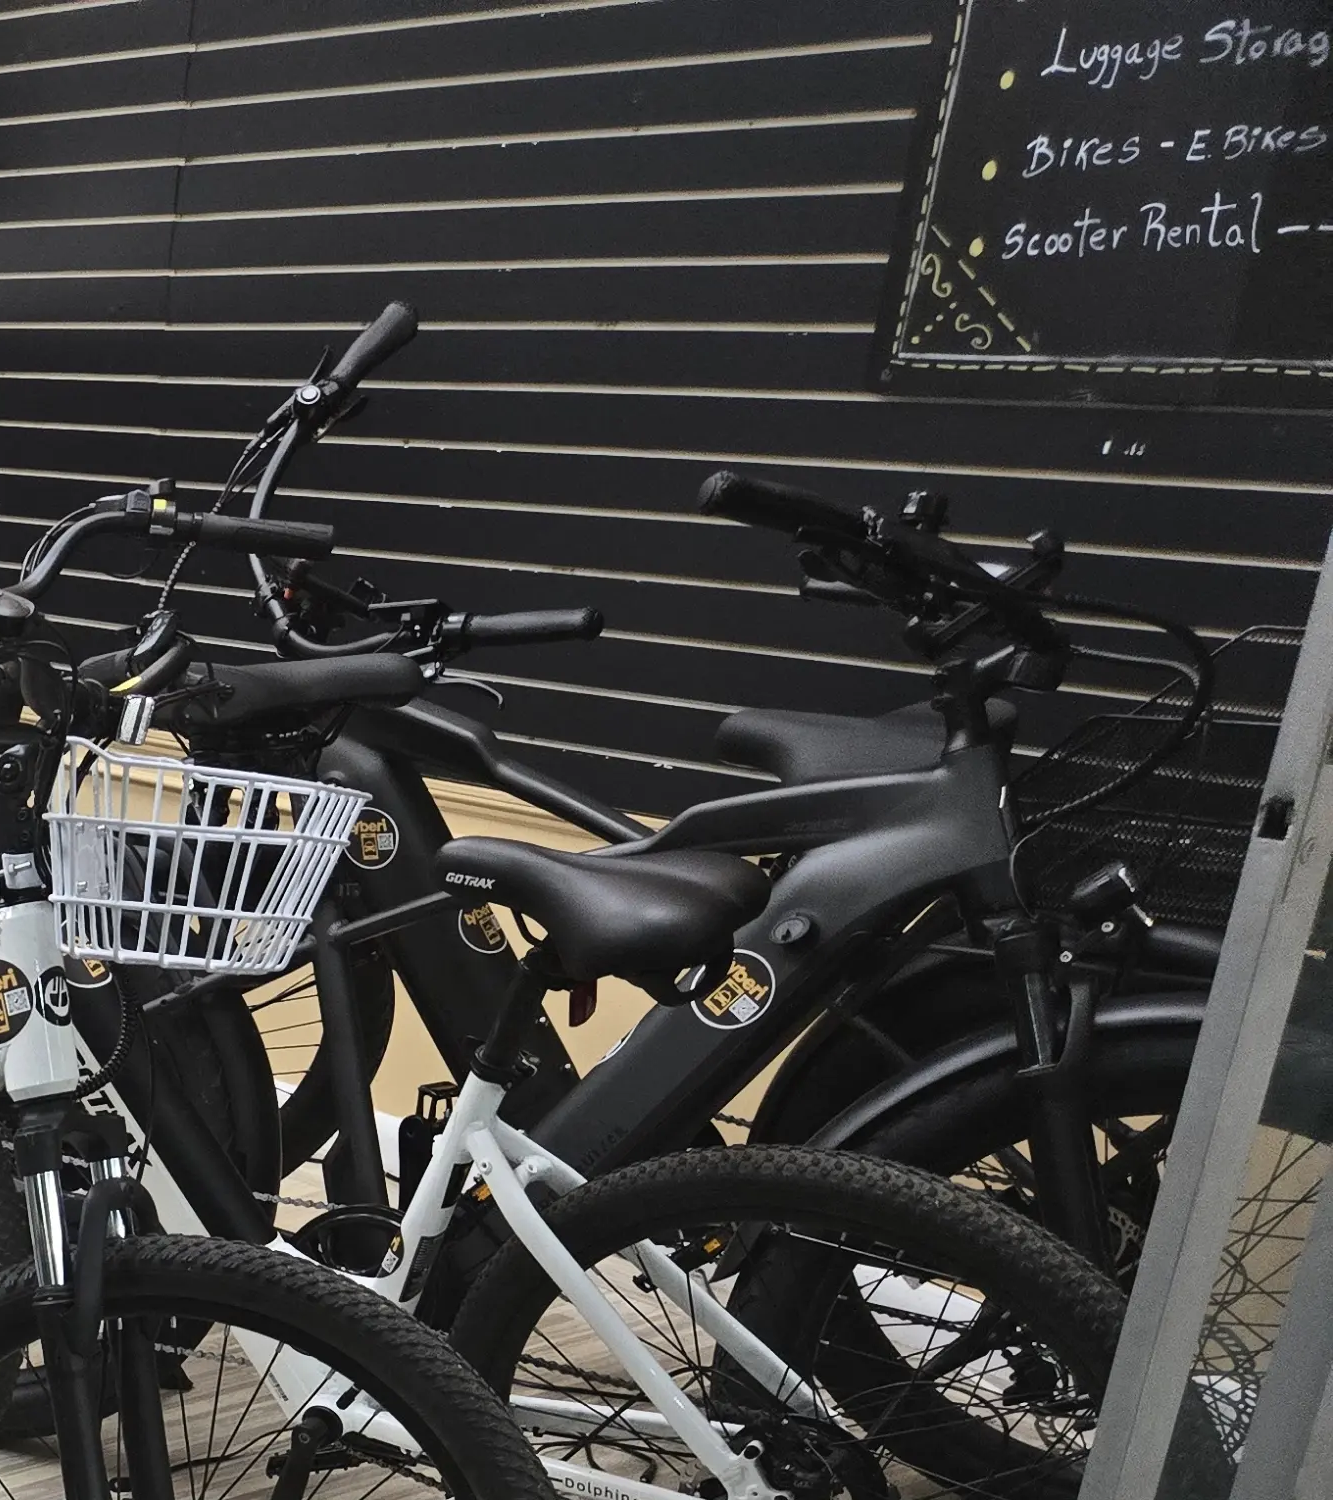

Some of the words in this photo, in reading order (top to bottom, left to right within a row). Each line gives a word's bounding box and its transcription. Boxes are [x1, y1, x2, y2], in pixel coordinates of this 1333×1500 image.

[1041, 27, 1182, 88] Luggage
[1022, 135, 1141, 178] Bikes
[1001, 207, 1128, 260] Scooter
[1139, 191, 1263, 254] Rental
[445, 872, 496, 890] GOTRAX
